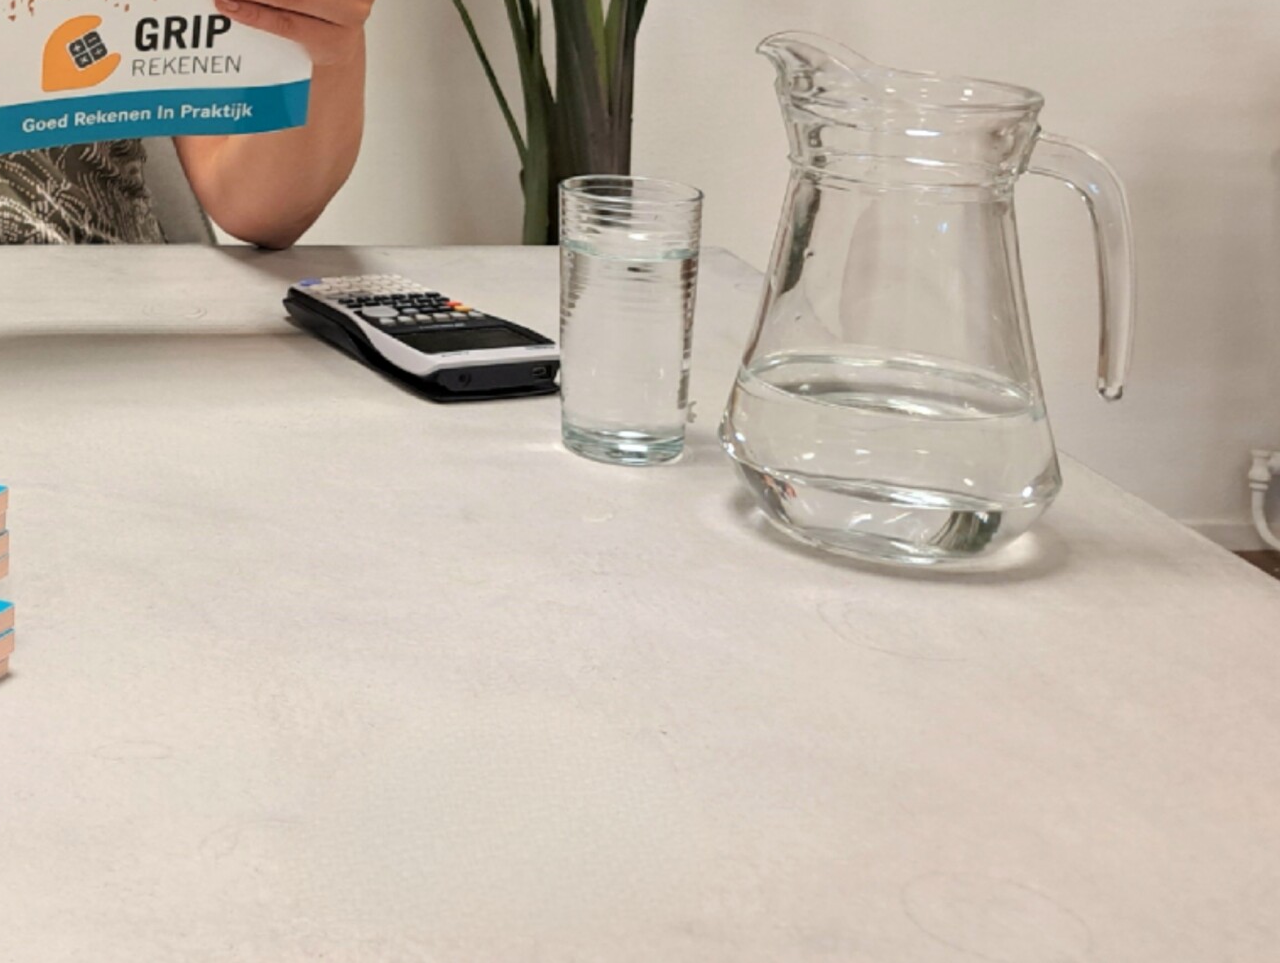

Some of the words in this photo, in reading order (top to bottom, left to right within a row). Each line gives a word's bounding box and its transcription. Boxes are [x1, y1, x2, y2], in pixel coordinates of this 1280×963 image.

[134, 14, 232, 52] GRIP
[131, 54, 242, 77] REKENEN
[22, 114, 69, 133] Goed
[74, 109, 152, 127] Rekenen
[157, 106, 174, 120] In
[180, 103, 253, 121] Praktijk
